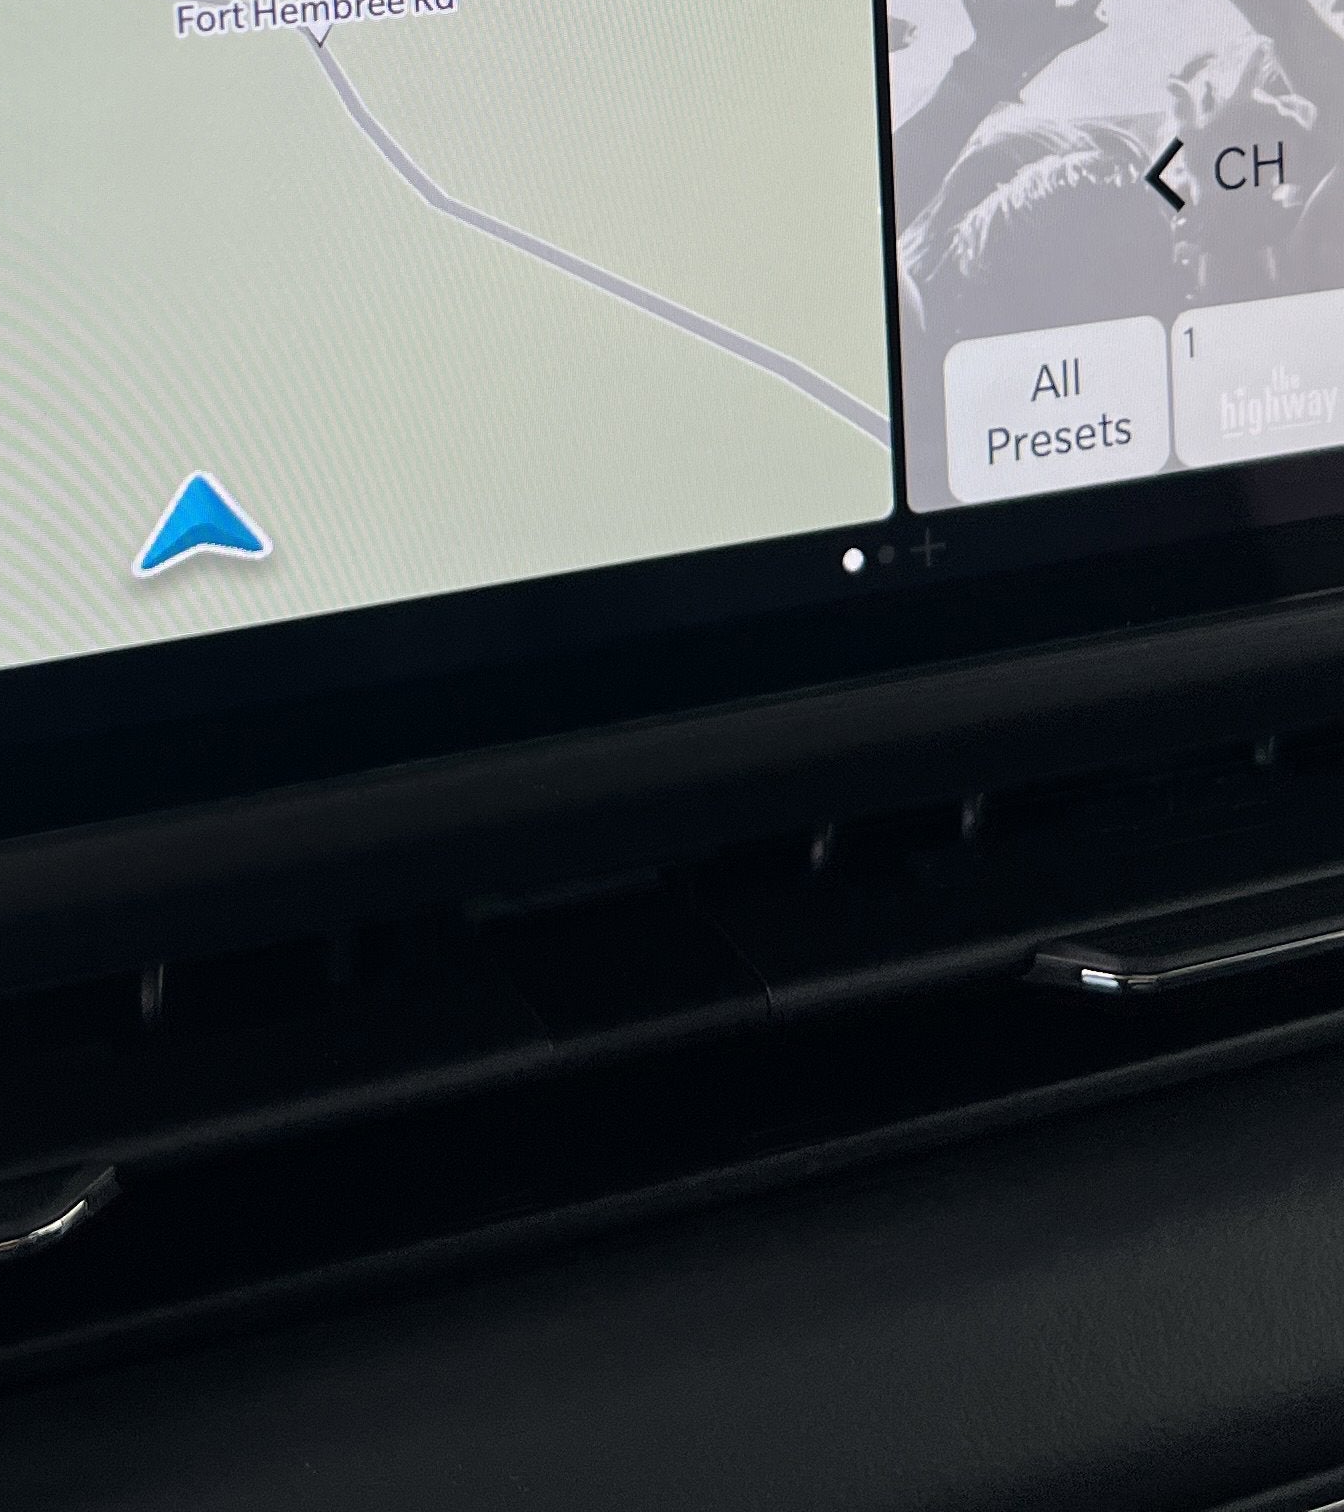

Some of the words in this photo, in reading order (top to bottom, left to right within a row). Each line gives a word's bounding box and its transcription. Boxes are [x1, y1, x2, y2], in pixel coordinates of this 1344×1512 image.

[176, 3, 245, 34] Fort
[1213, 141, 1285, 190] CH
[1183, 327, 1197, 359] 1
[1030, 357, 1082, 402] All
[1219, 387, 1338, 436] highway
[987, 414, 1133, 465] Presets
